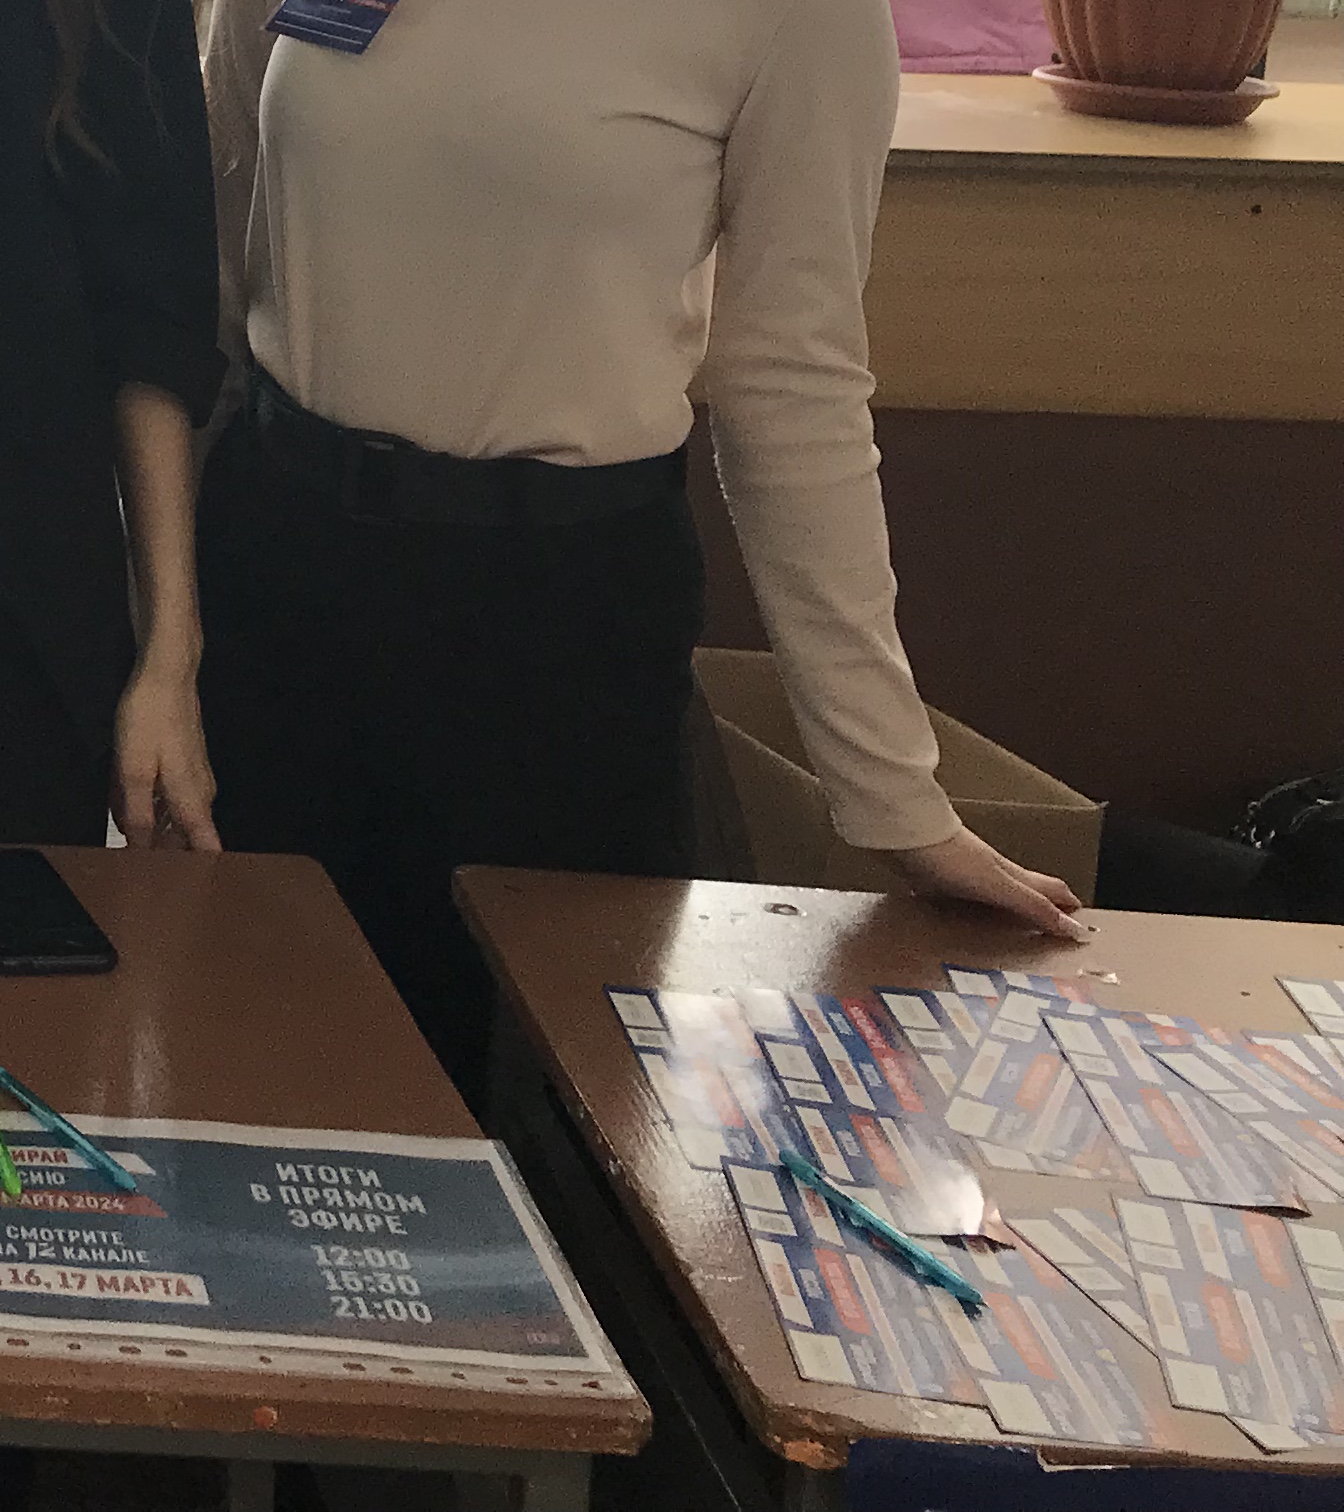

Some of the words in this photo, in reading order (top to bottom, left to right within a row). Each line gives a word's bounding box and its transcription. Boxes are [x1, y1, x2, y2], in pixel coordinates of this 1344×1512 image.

[275, 1162, 382, 1188] ИТОГИ
[73, 1194, 127, 1211] 2024
[249, 1183, 272, 1204] В
[278, 1184, 427, 1215] ПРЯМОМ
[288, 1207, 409, 1236] ЭФИРЕ
[5, 1224, 125, 1247] СМОТРИТЕ
[25, 1242, 56, 1260] 12
[62, 1246, 151, 1265] КАНАЛЕ
[311, 1244, 412, 1271] 12:00
[58, 1271, 87, 1291] 17
[95, 1273, 194, 1298] МАРТА
[330, 1296, 433, 1325] 21:00
